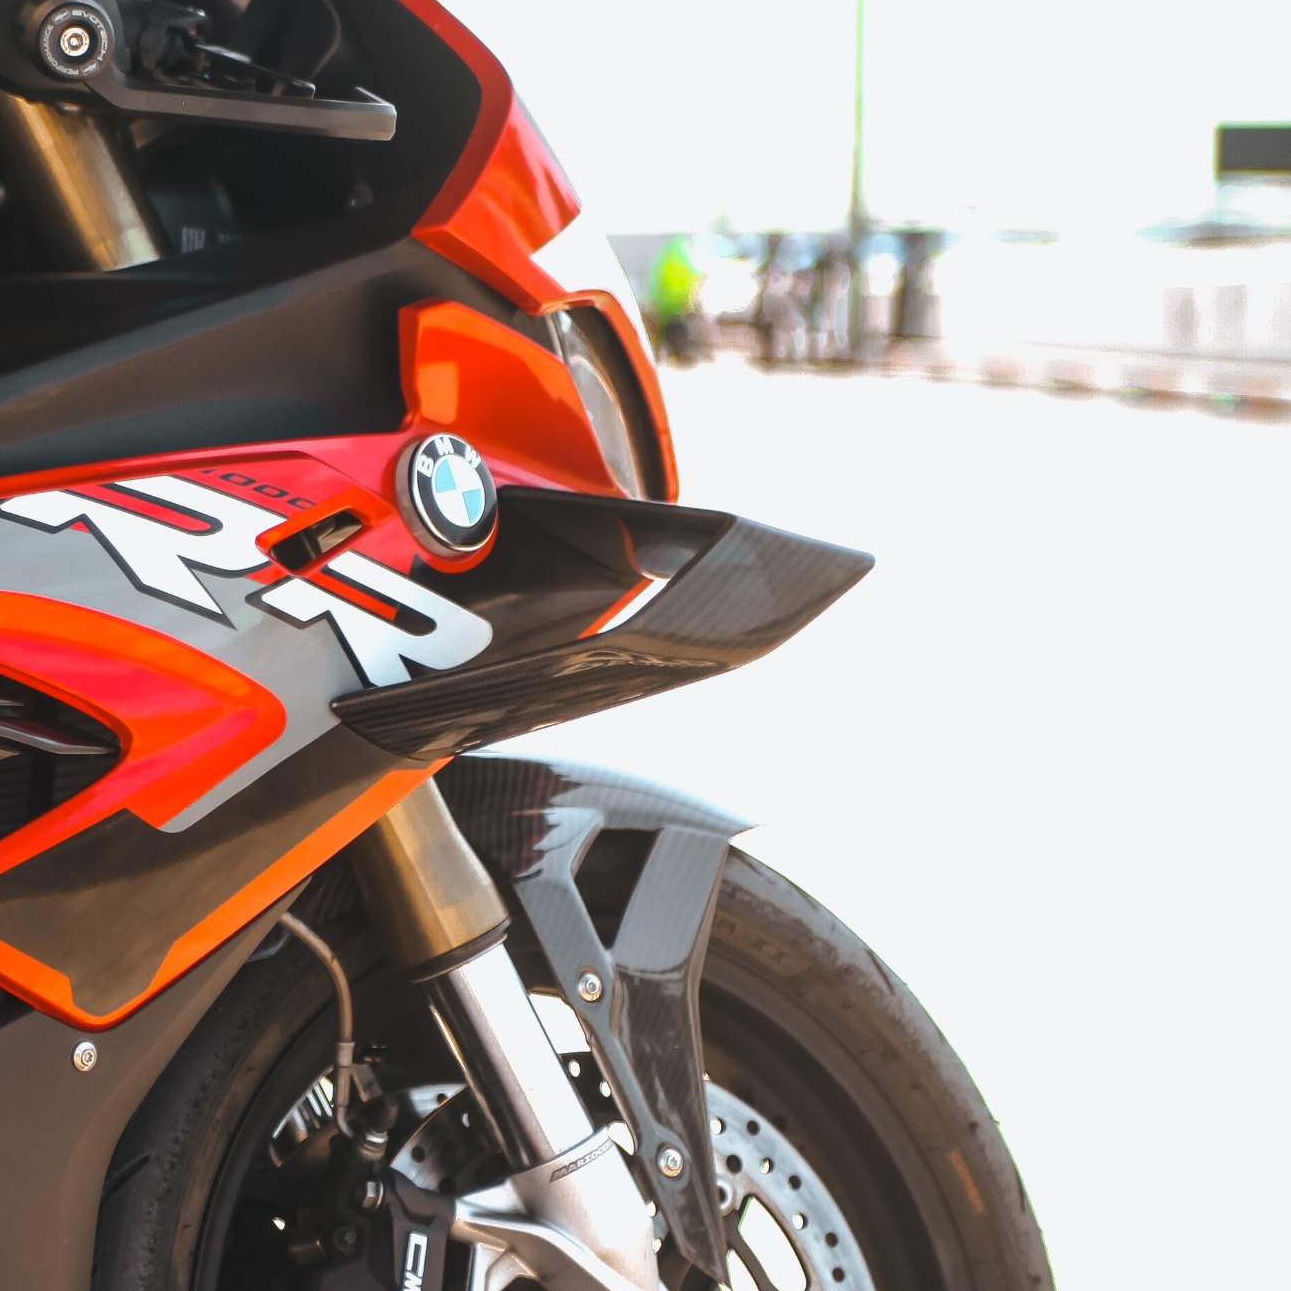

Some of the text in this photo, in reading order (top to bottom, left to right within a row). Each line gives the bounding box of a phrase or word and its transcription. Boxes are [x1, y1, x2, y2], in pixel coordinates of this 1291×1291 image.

[42, 23, 79, 75] PERFORMANCE
[72, 9, 108, 61] EVOTECH
[417, 436, 482, 478] BMW
